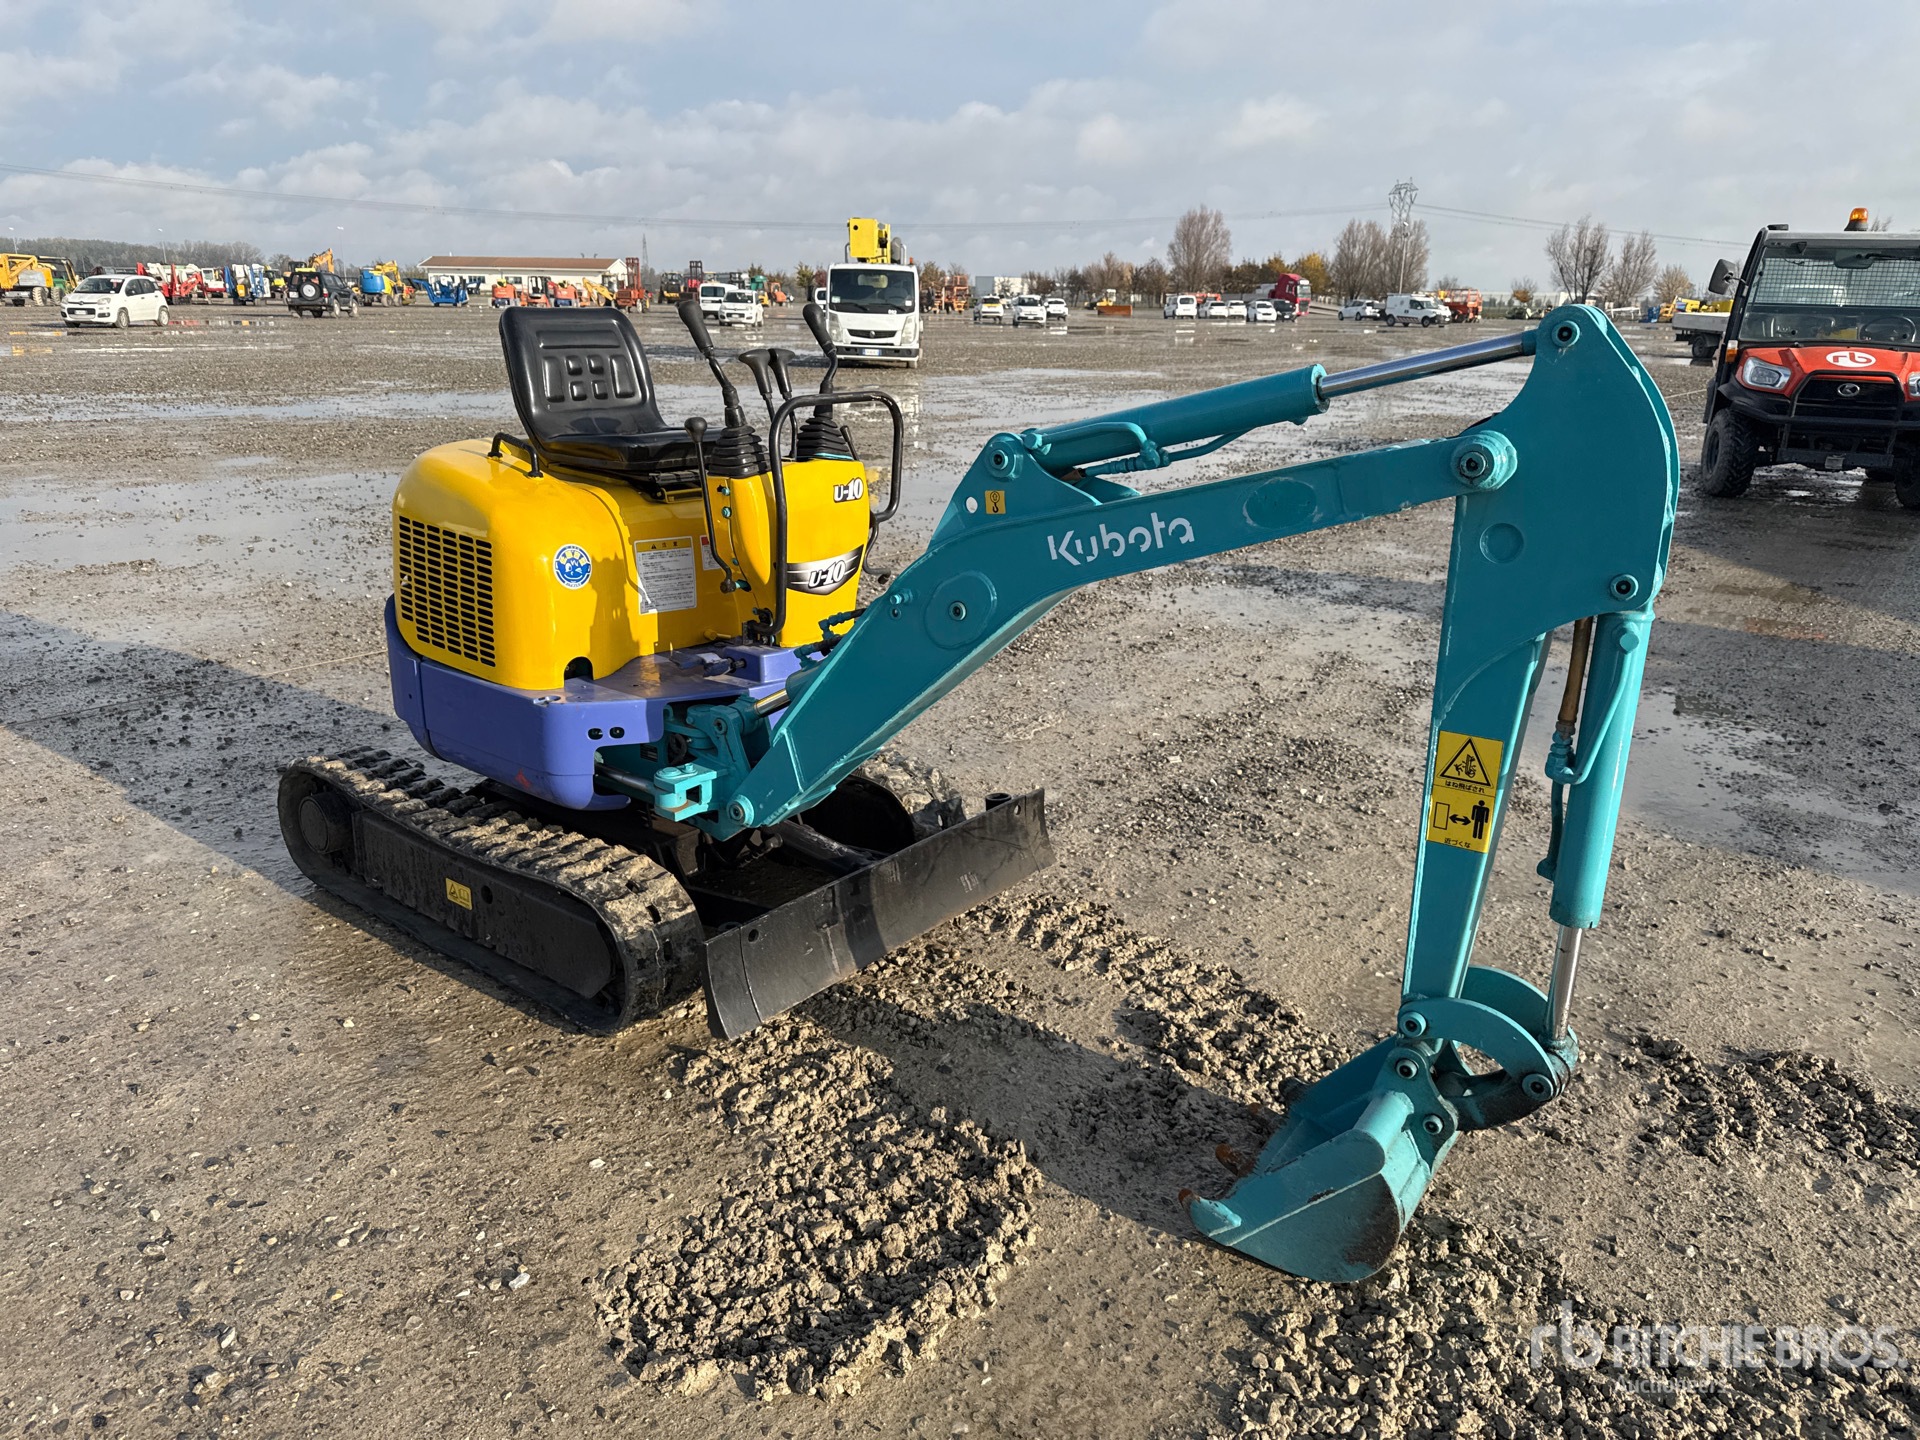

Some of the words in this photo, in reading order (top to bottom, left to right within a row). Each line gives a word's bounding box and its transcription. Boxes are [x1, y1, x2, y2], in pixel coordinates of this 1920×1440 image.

[833, 477, 864, 503] U-10
[1047, 512, 1195, 566] Kubota
[809, 560, 847, 588] U-10
